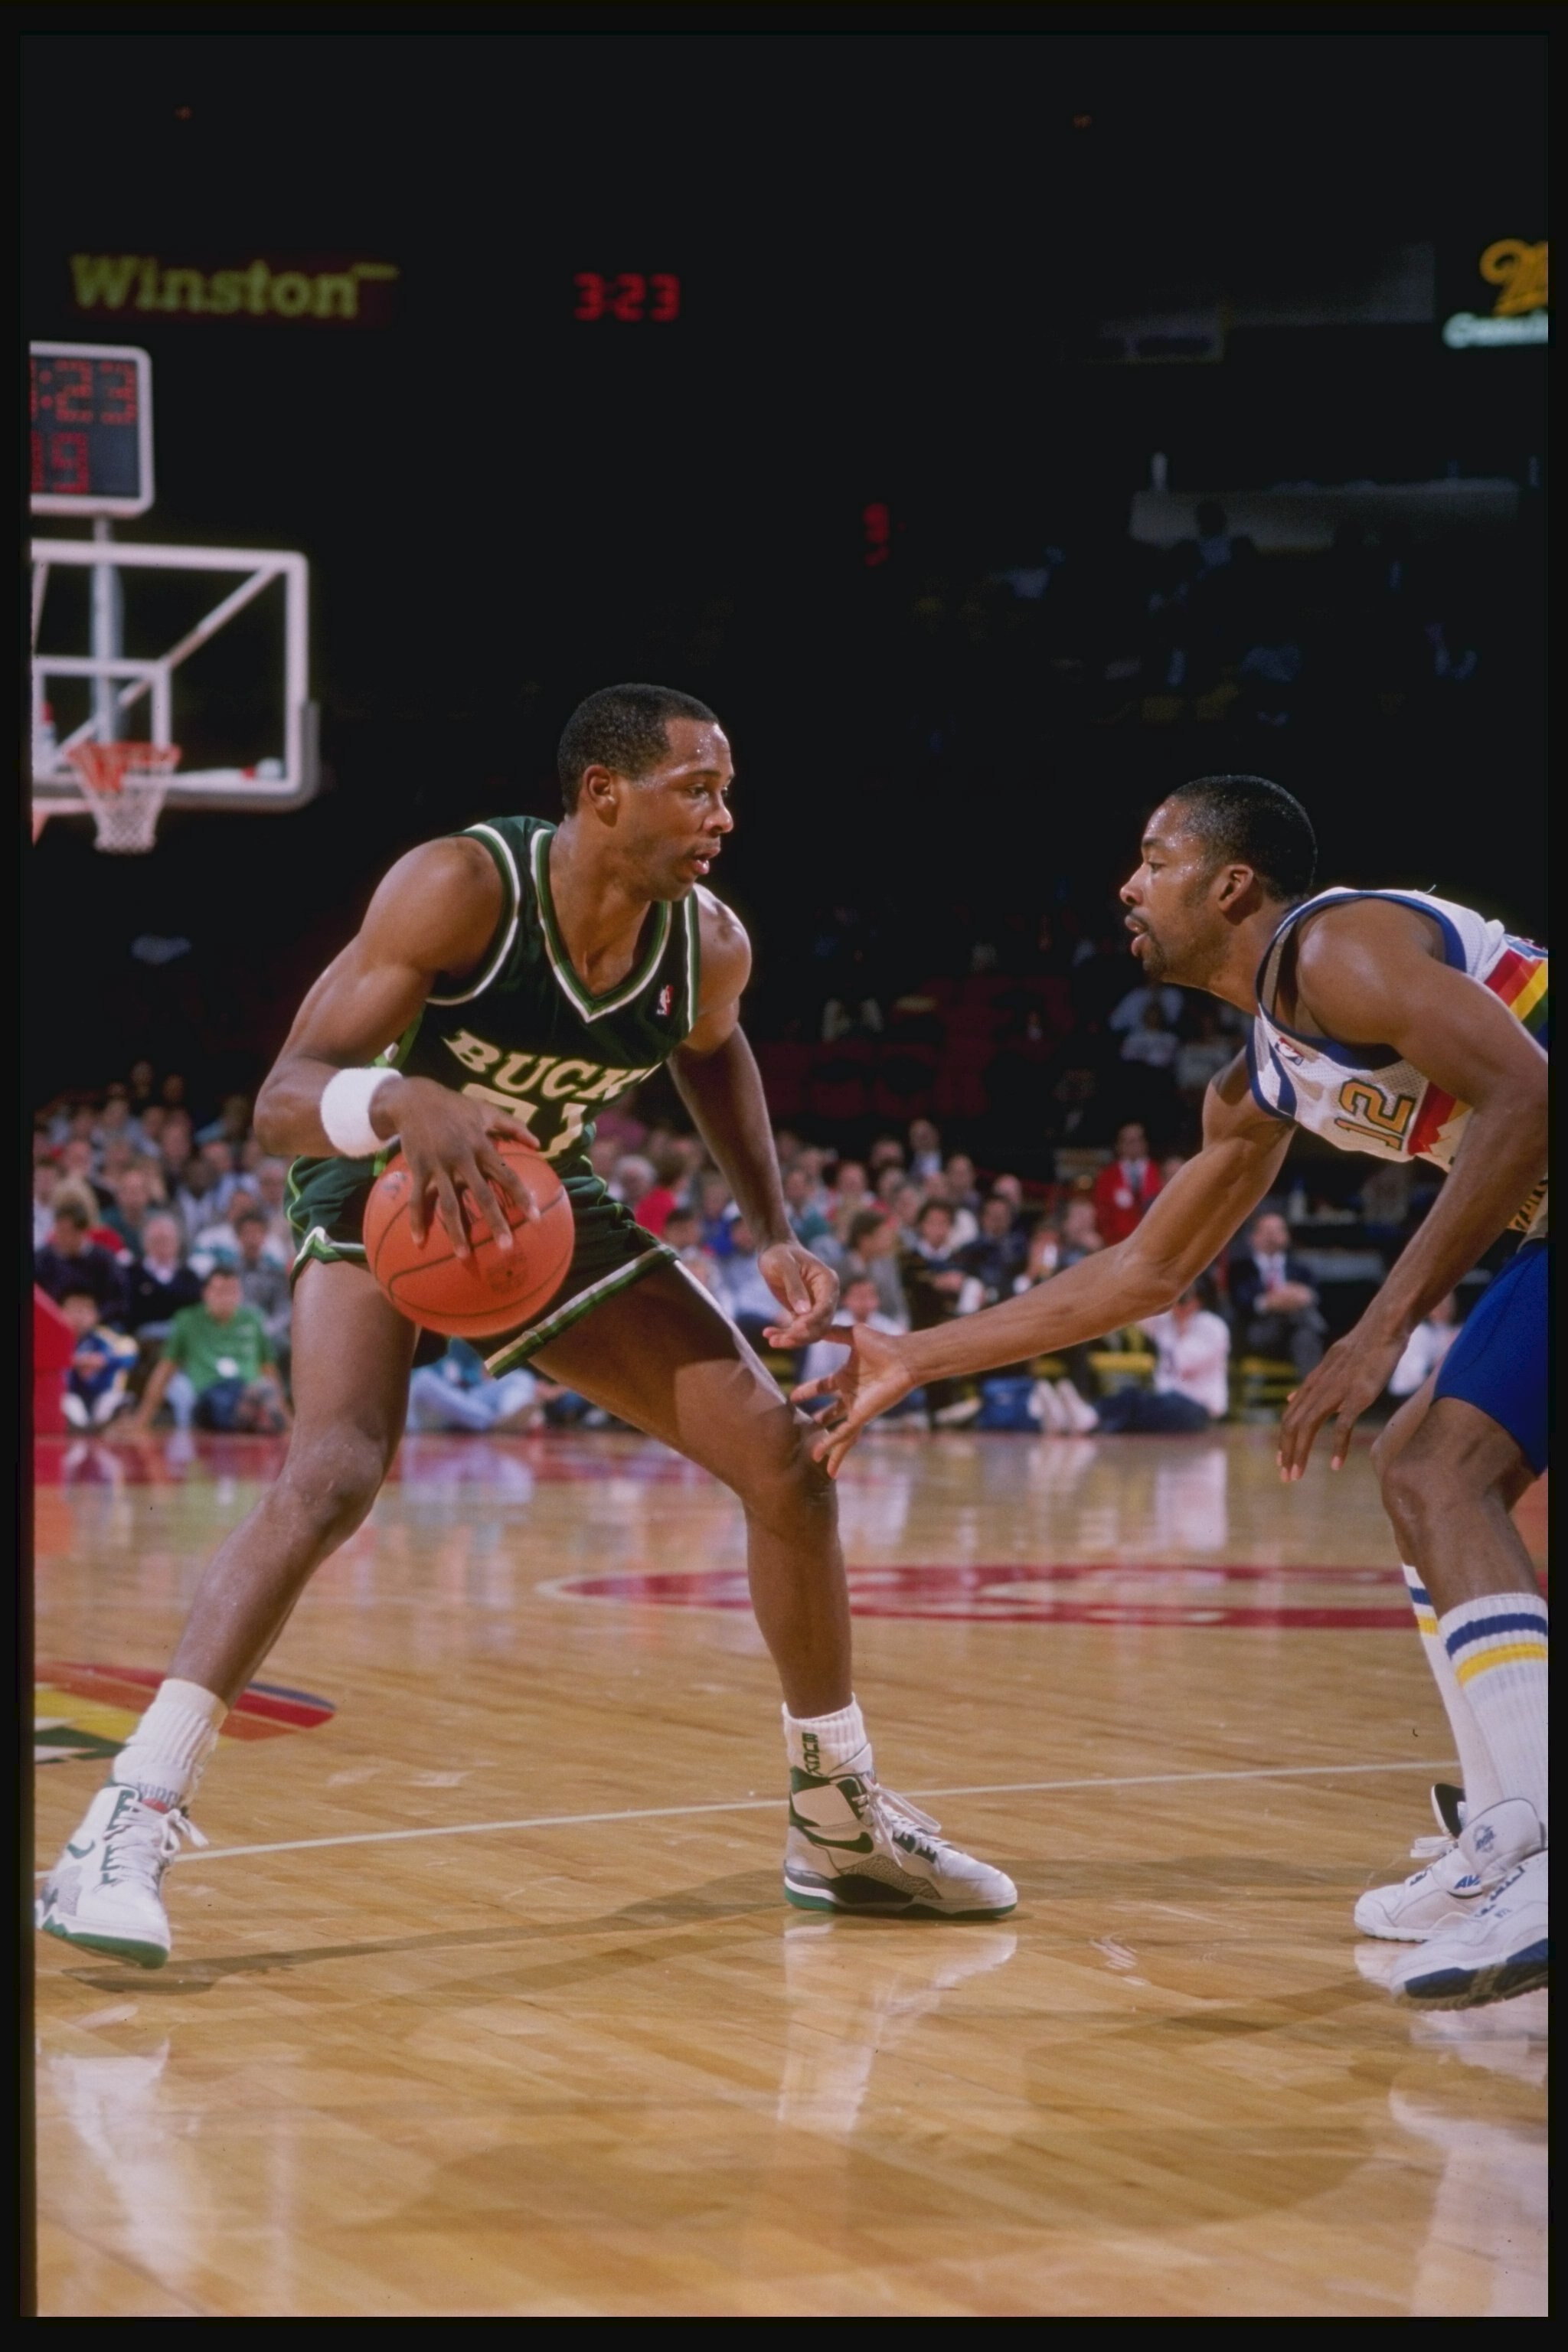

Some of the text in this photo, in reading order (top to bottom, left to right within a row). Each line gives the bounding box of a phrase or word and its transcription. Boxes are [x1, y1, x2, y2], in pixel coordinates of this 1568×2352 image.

[70, 253, 360, 319] Winston
[573, 271, 681, 322] 3:23
[30, 357, 137, 425] :23
[441, 1029, 662, 1100] BUCK
[1334, 1077, 1417, 1151] 12
